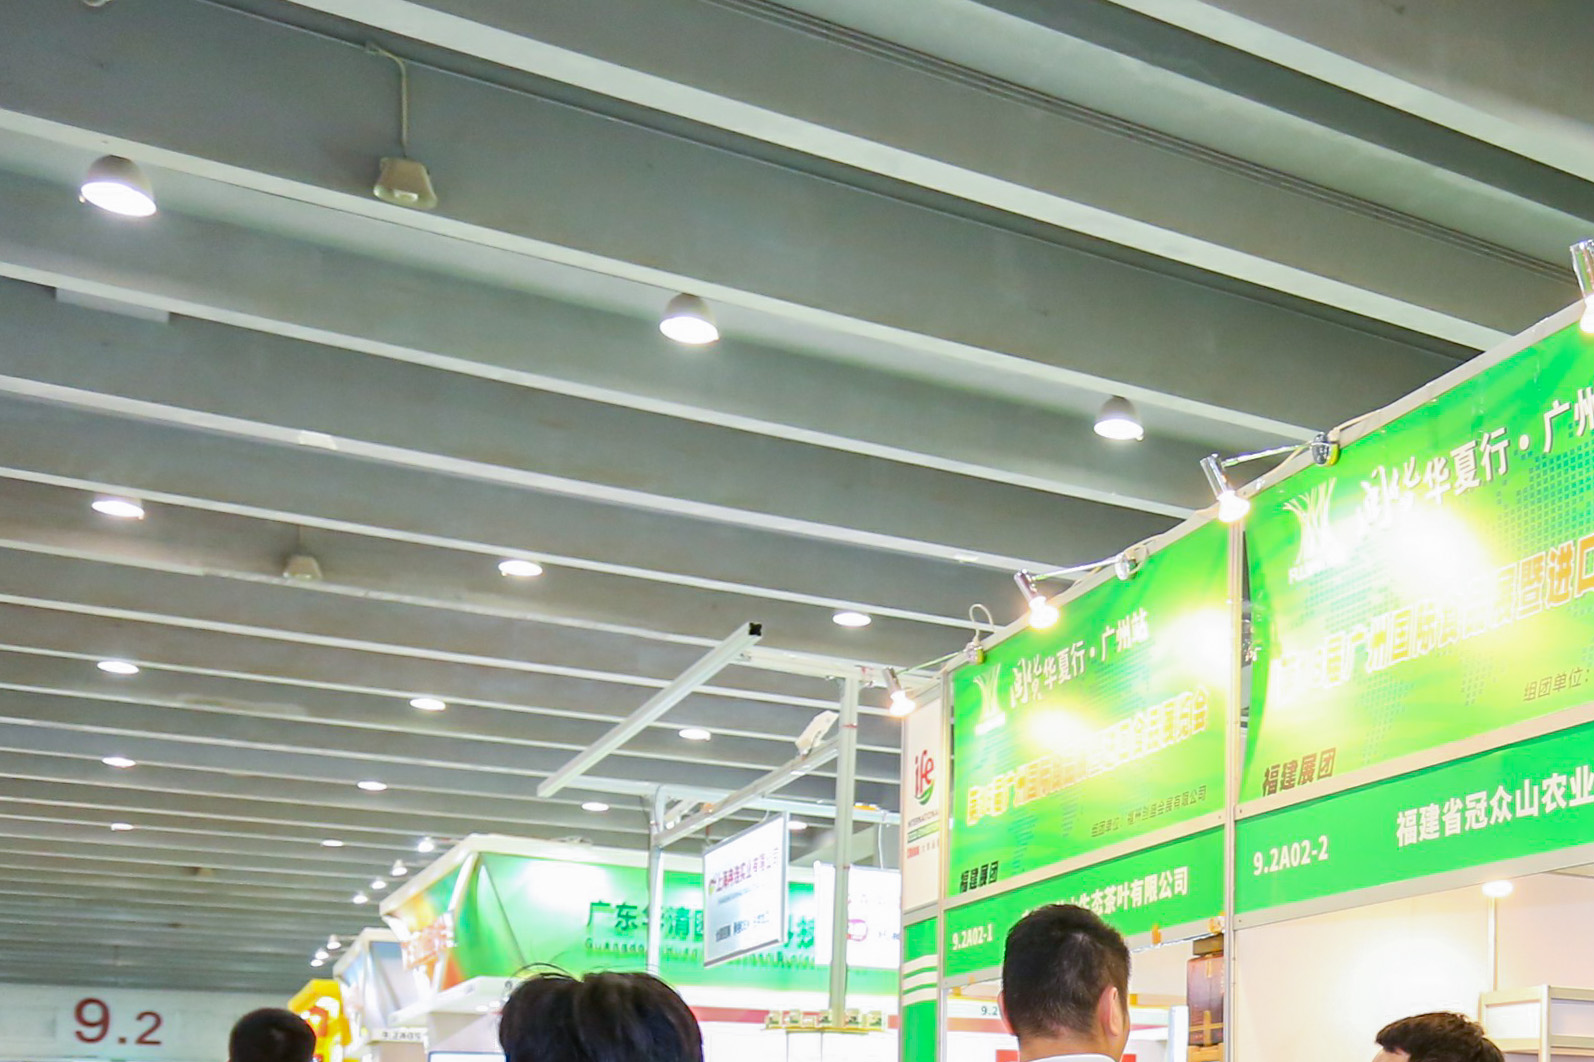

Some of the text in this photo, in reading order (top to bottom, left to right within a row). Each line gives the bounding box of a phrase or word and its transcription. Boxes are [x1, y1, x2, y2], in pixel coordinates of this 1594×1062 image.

[1262, 746, 1336, 797] 福建展团
[1253, 834, 1329, 877] 9.2A02-2
[952, 924, 993, 951] 9.2A02-1
[74, 998, 162, 1045] 9.2
